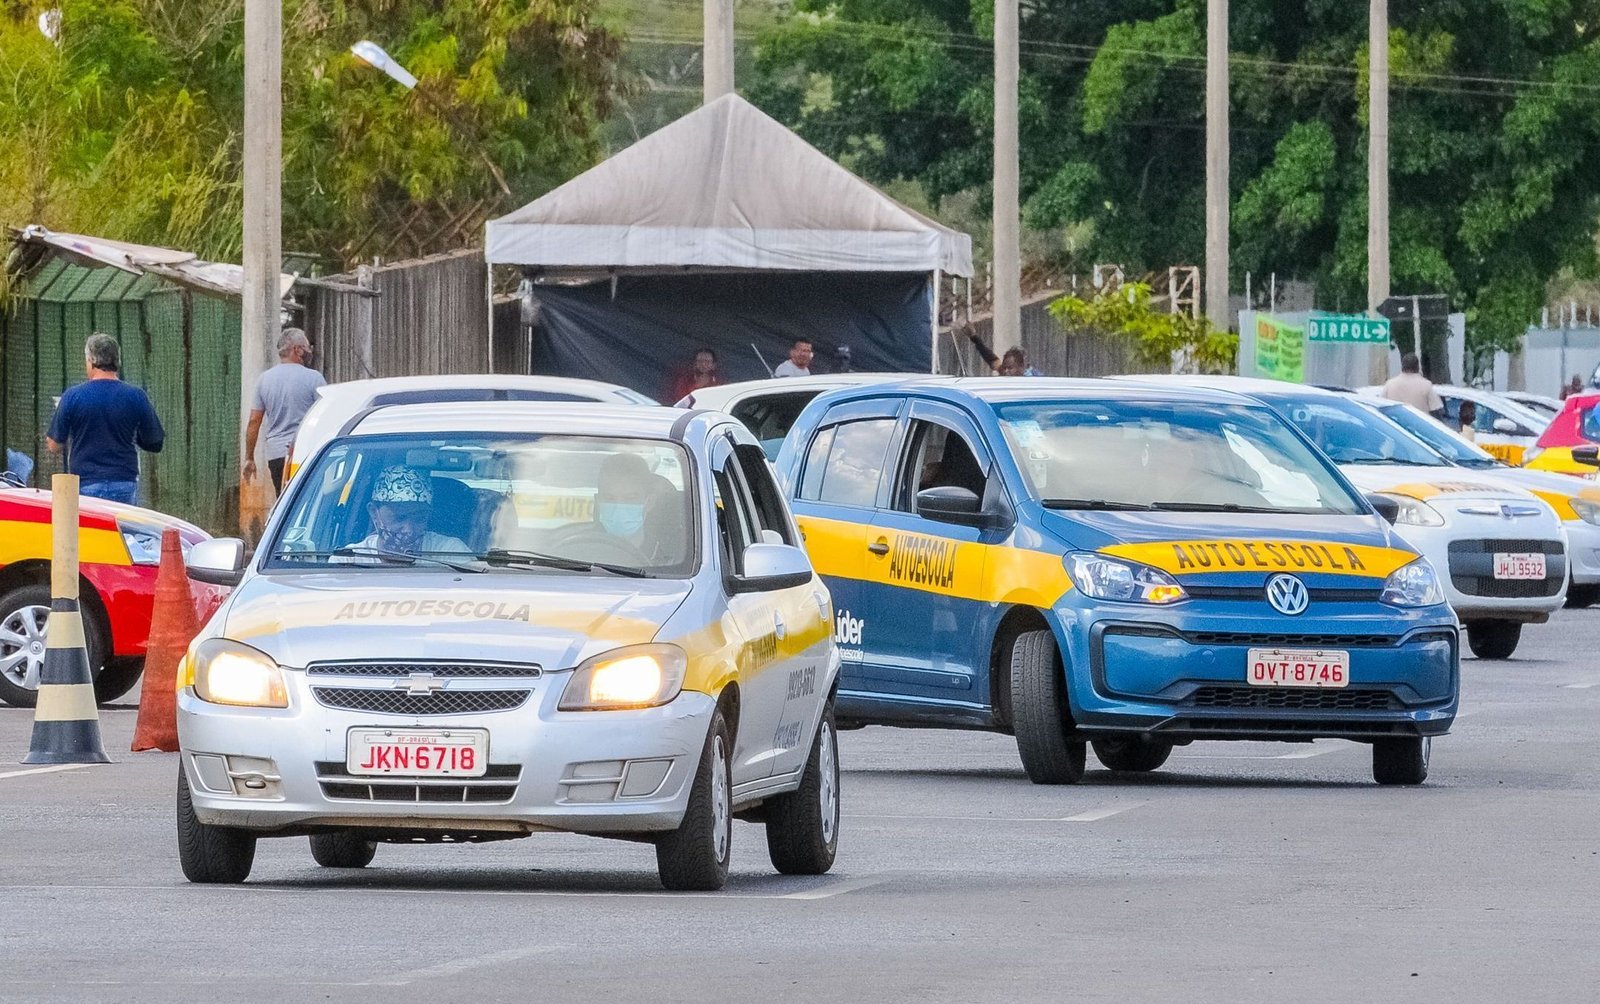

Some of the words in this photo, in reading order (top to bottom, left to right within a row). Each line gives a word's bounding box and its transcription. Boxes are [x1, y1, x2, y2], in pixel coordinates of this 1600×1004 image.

[1309, 321, 1372, 339] DIRPOL
[889, 534, 957, 588] AUTOESCOLA
[1172, 542, 1366, 571] AUTOESCOLA
[334, 600, 530, 622] AUTOESCOLA
